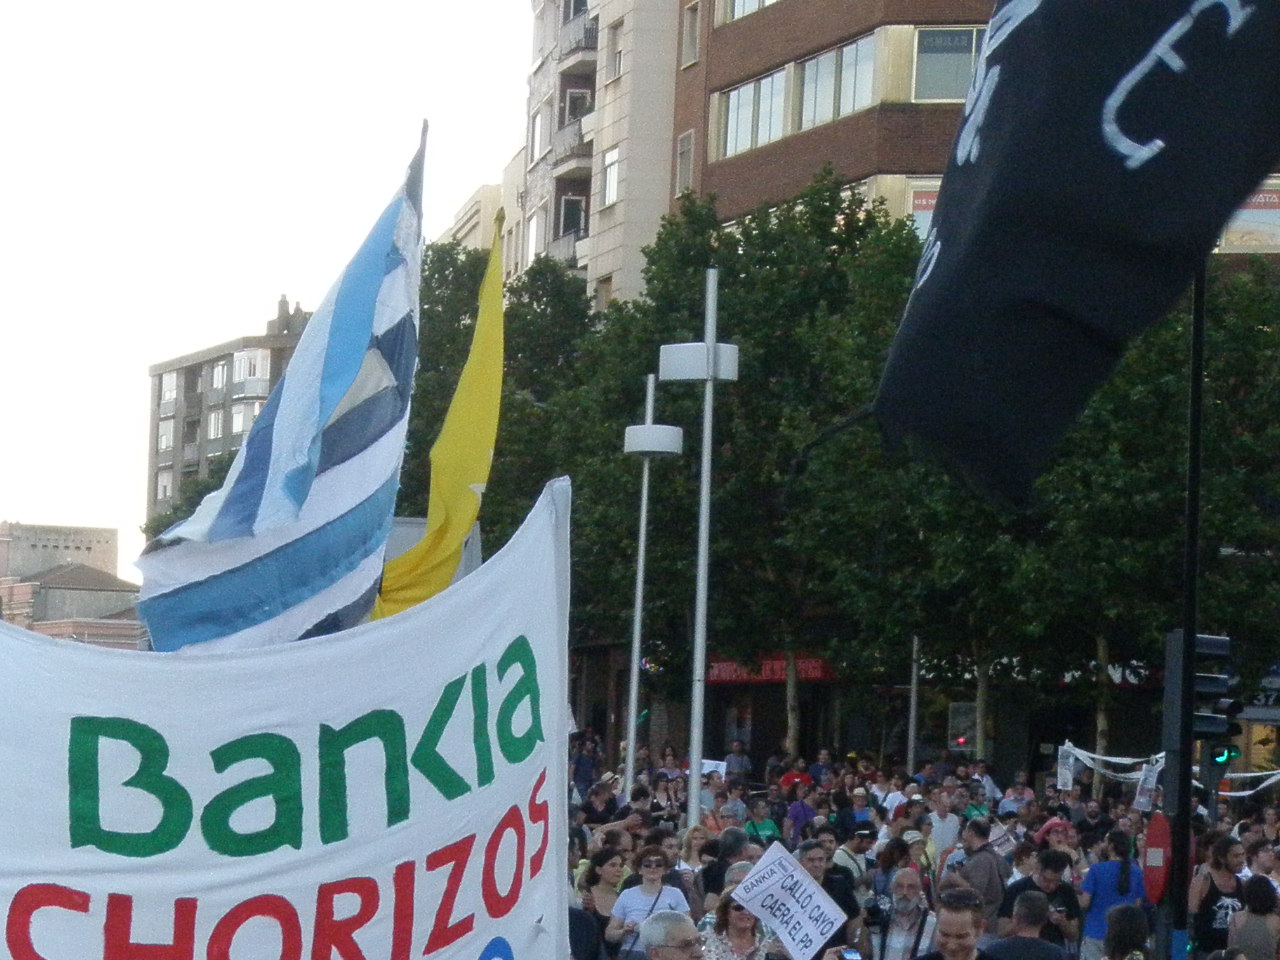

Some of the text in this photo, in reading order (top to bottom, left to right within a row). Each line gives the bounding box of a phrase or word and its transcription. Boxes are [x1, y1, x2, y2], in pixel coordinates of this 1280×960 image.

[742, 867, 779, 895] BANKIA
[760, 892, 798, 928] CAERÁ
[787, 920, 803, 942] EL
